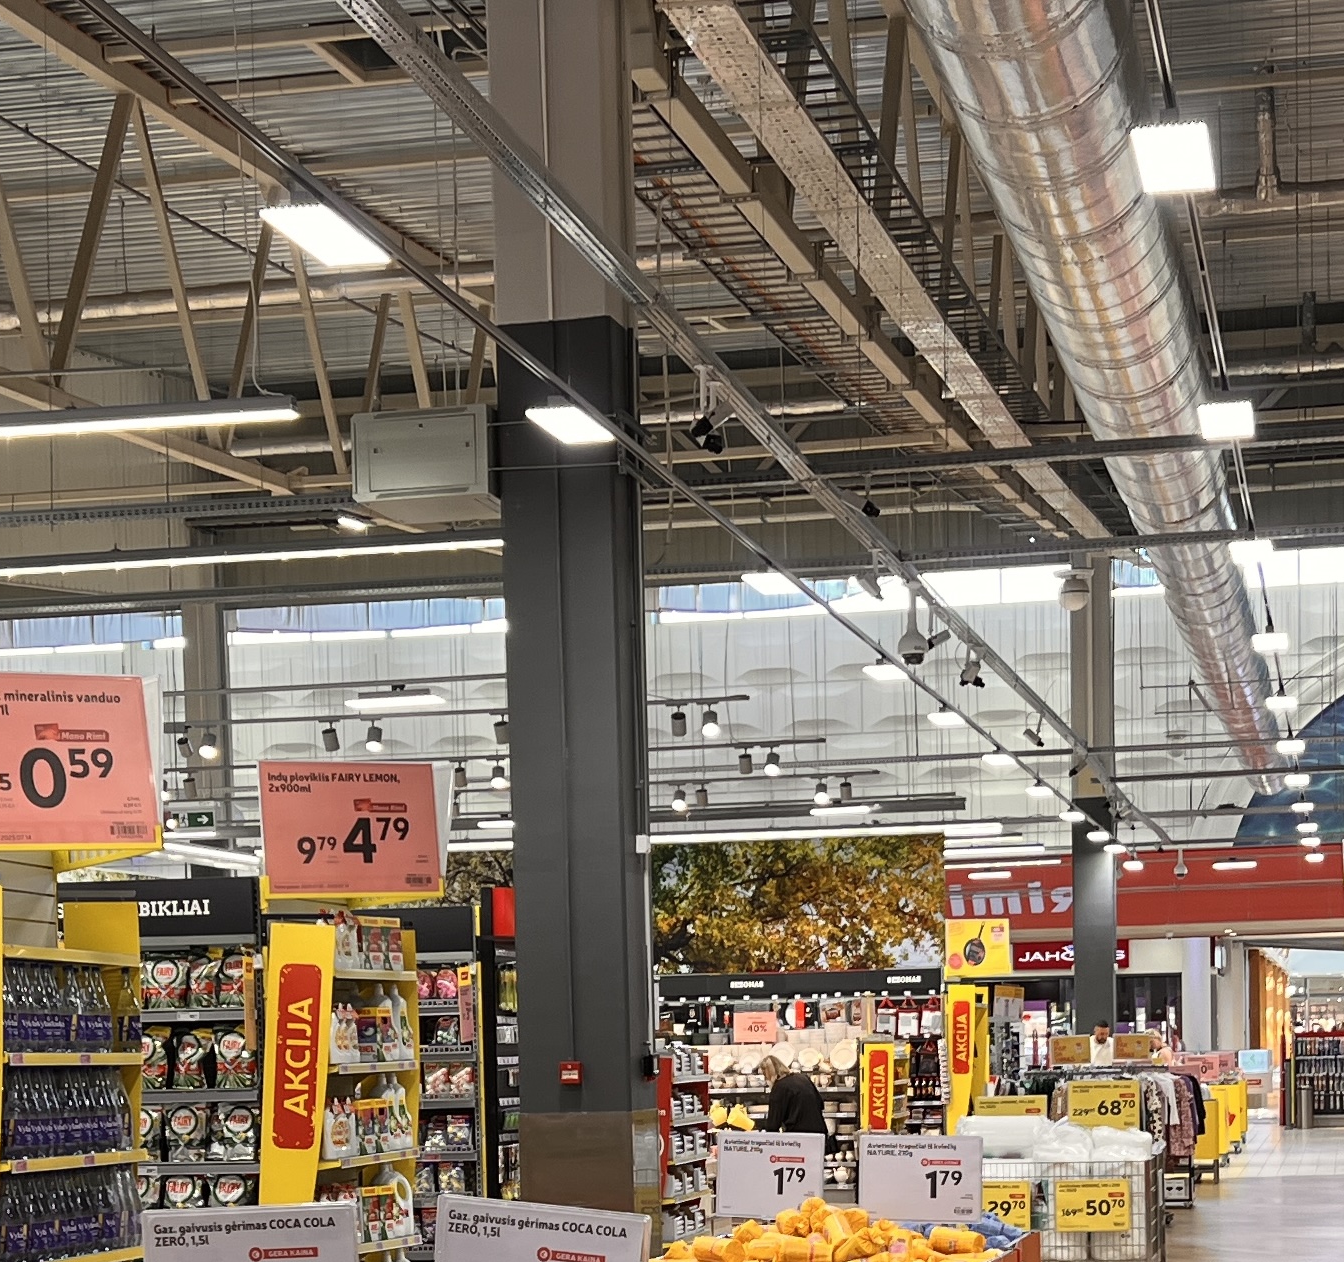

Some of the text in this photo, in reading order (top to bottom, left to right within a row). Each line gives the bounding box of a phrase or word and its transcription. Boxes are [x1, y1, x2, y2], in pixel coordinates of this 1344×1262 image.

[4, 689, 73, 704] mineralinis
[76, 691, 121, 705] vanduo
[20, 747, 113, 809] 059
[268, 783, 312, 793] 2x900ml
[290, 773, 330, 785] ploviklis
[331, 773, 360, 782] FAIRY
[363, 773, 401, 783] LEMON,
[297, 817, 410, 864] 979 479
[139, 899, 210, 917] BIKLIAI
[956, 1014, 969, 1062] AKCIJA
[283, 997, 314, 1118] AKCIJA
[872, 1064, 886, 1119] AKCIJA
[1097, 1100, 1136, 1116] 6870
[773, 1167, 806, 1195] 179
[926, 1170, 963, 1199] 179
[1086, 1199, 1125, 1215] 5070
[154, 1217, 336, 1236] Gaz. gaivusis gėrimas COCA COLA
[448, 1209, 628, 1239] Gaz. gaivusis gėrimas COCA COLA
